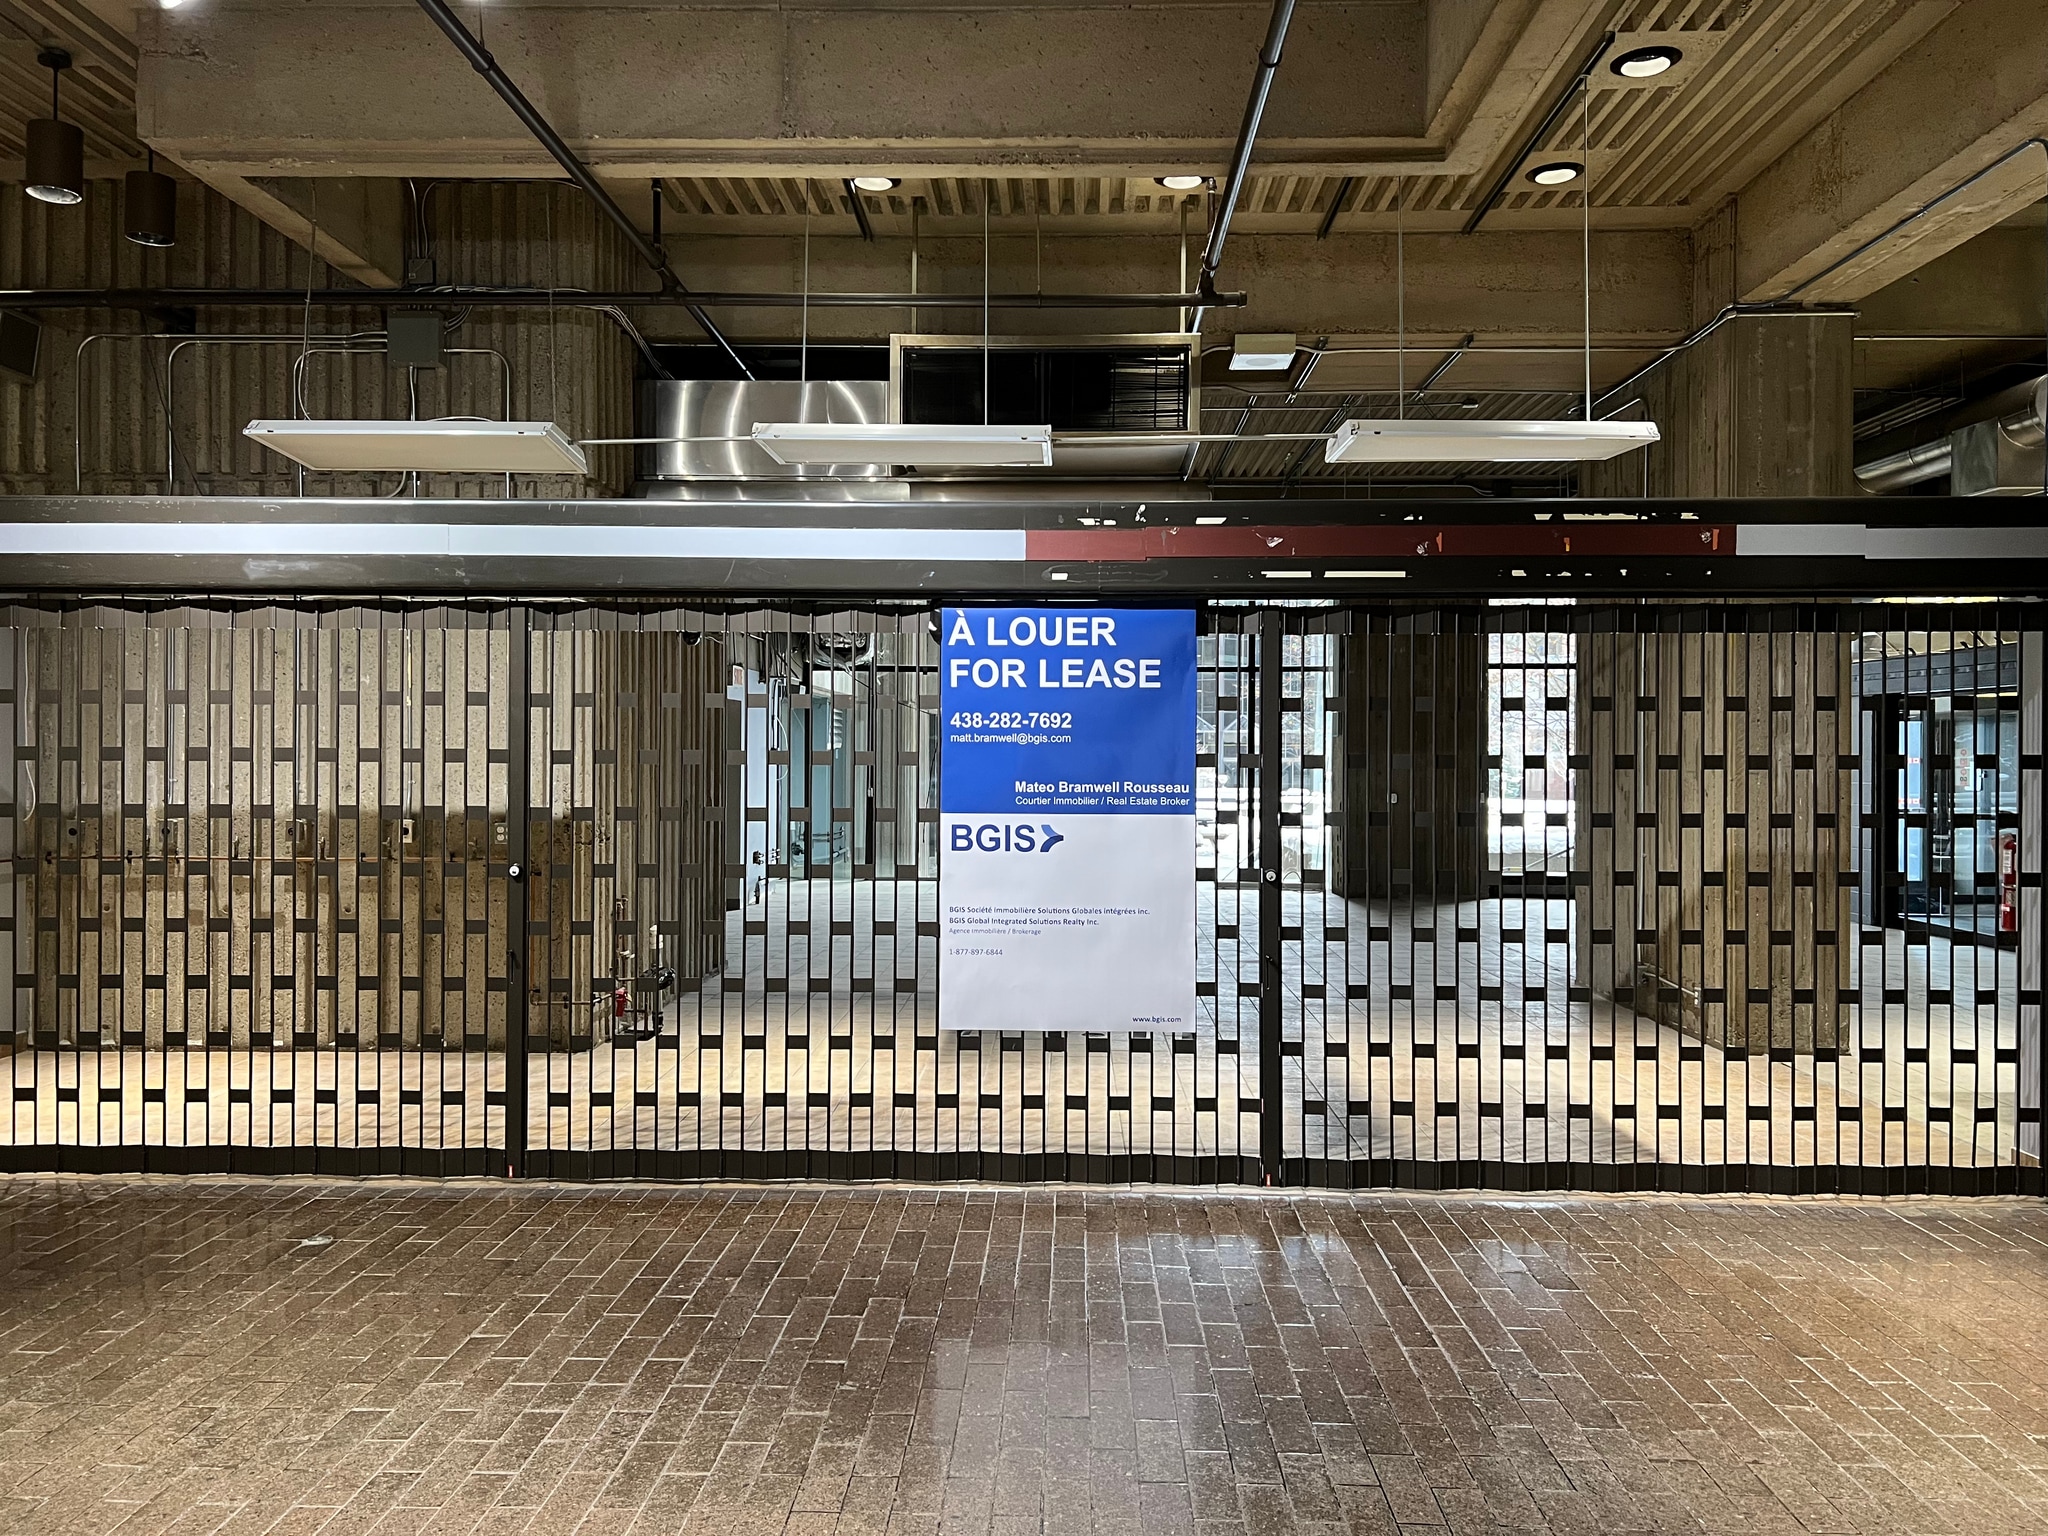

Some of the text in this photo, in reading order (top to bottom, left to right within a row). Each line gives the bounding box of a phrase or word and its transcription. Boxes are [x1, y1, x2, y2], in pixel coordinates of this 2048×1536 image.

[948, 610, 1117, 647] À LOUER
[950, 659, 1162, 689] FOR LEASE
[950, 712, 1072, 729] 438-282-7692
[950, 733, 1072, 745] matt.bramwell@bgis.com
[1015, 781, 1190, 793] Mateo Bramwell Rousseau
[1015, 796, 1051, 806] Courtier
[1053, 796, 1099, 806] Immobilier
[1106, 797, 1128, 805] Real
[1129, 797, 1158, 806] Estate
[1160, 797, 1190, 806] Broker
[951, 824, 1036, 853] BGIS
[967, 905, 992, 914] Société
[1071, 907, 1102, 915] Globales
[967, 917, 990, 925] Global
[991, 918, 1028, 926] Integrated
[1063, 918, 1086, 926] Realty
[1086, 918, 1100, 926] Inc.
[949, 927, 971, 935] Agence
[1012, 928, 1042, 936] Brokerage
[949, 948, 1003, 956] 1-877-897-6844
[1132, 1016, 1181, 1024] www.bgis.com
